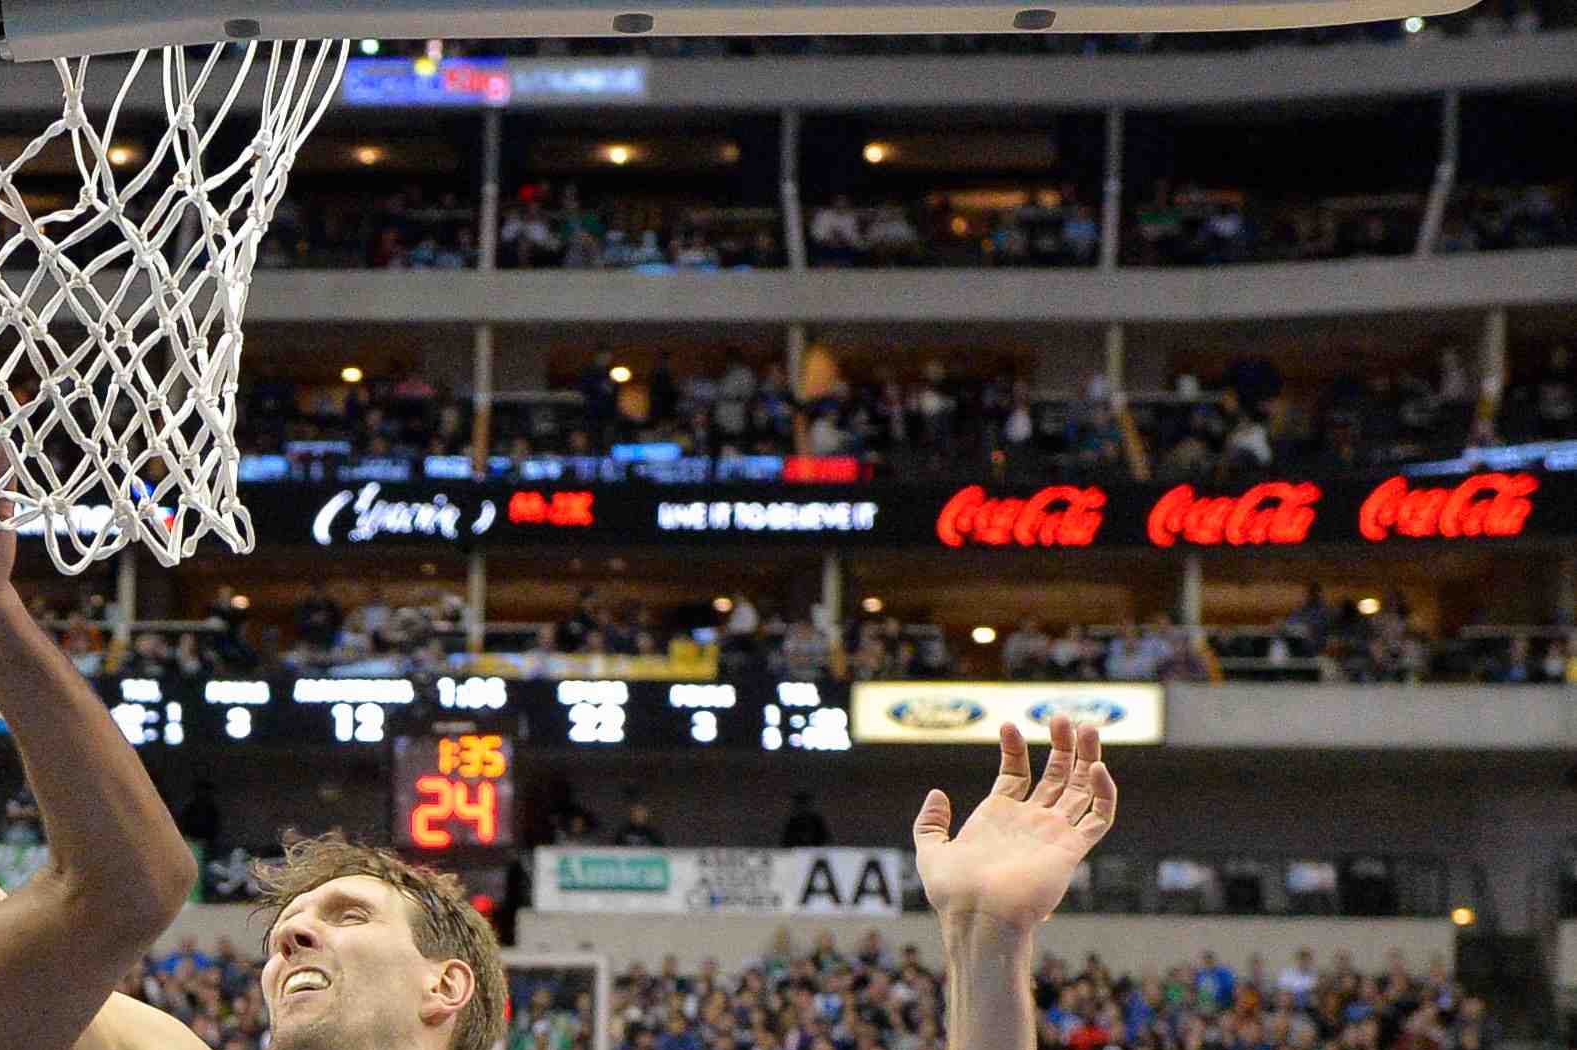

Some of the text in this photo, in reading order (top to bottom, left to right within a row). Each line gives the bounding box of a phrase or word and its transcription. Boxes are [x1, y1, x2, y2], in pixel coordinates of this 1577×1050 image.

[437, 734, 507, 778] 1:35
[409, 774, 498, 848] 24
[799, 857, 893, 905] AA
